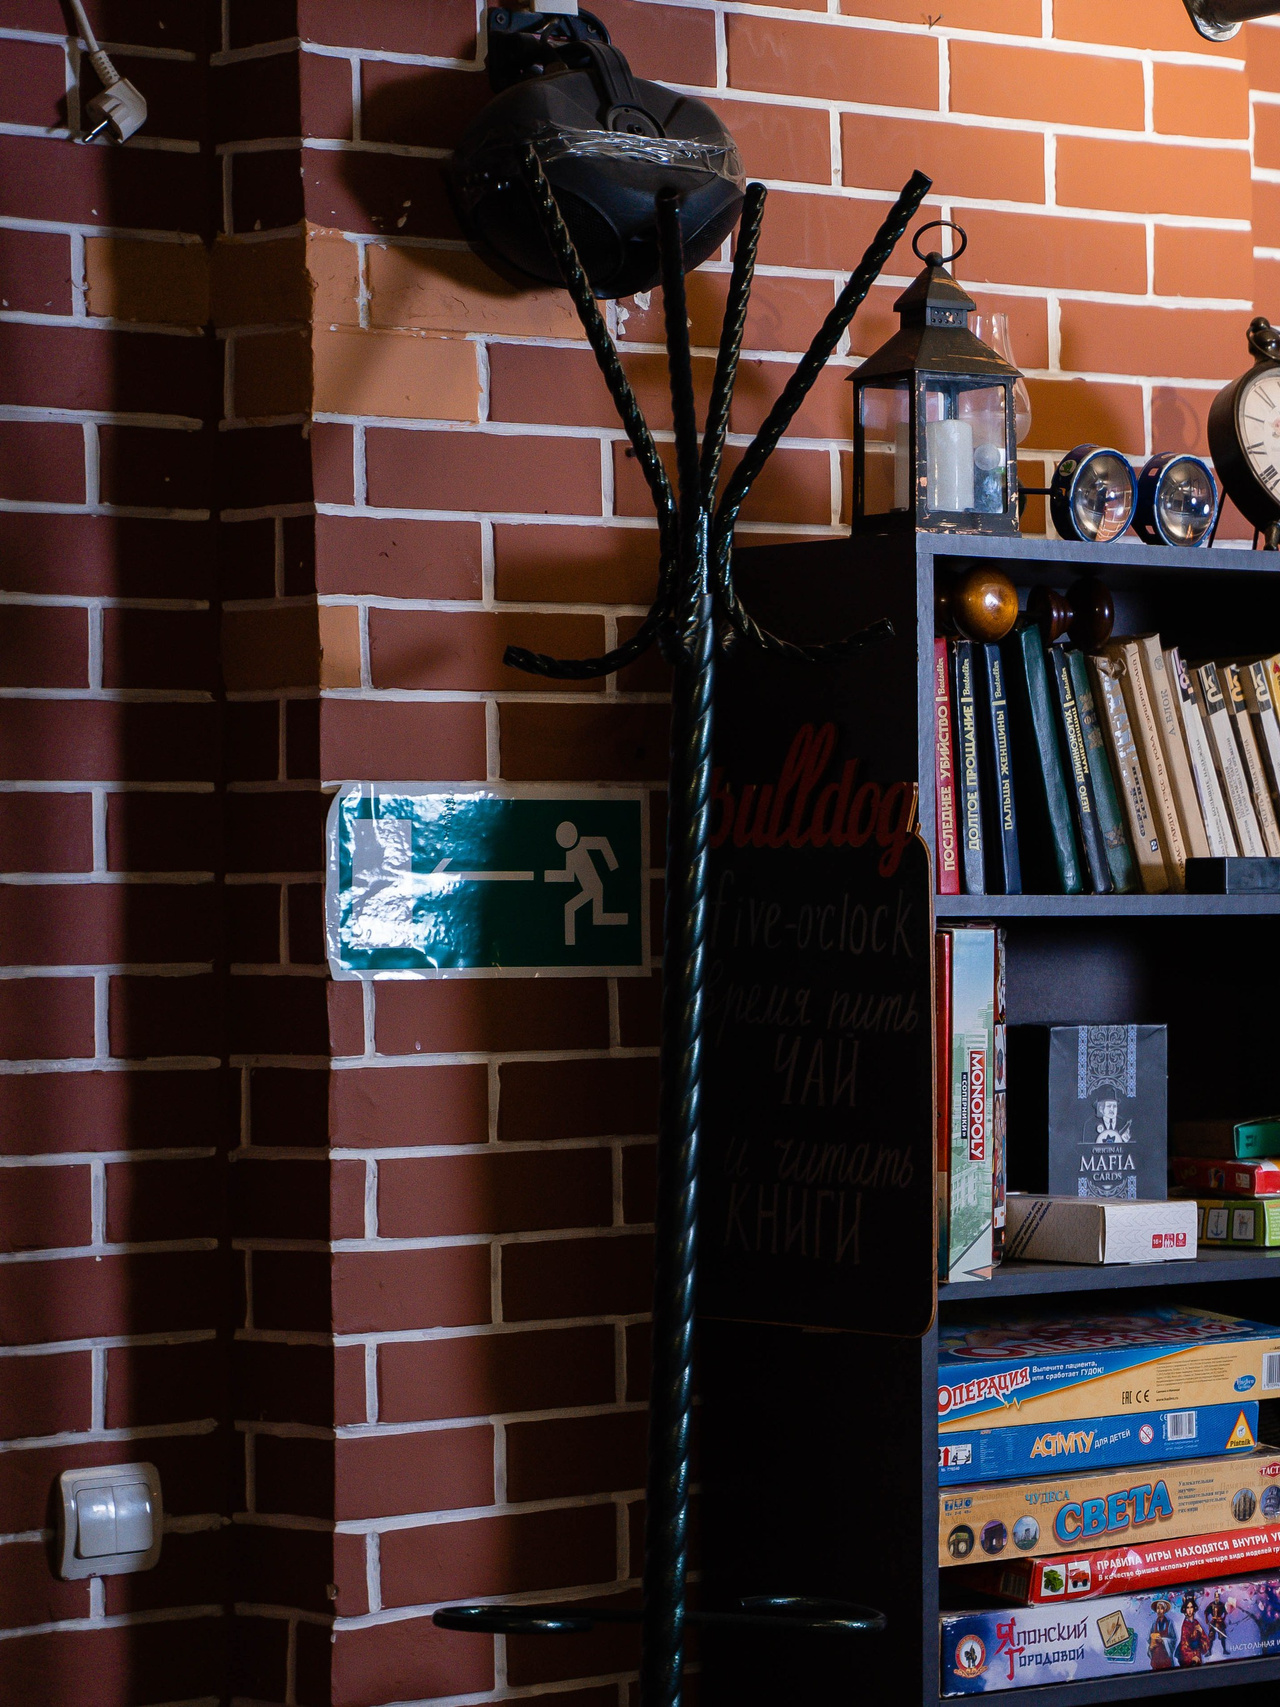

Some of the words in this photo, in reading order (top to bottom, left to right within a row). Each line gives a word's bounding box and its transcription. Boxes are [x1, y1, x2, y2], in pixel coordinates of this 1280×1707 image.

[937, 657, 945, 695] Bestseller
[962, 658, 971, 696] Bestseller
[991, 660, 1000, 699] Bestseller
[1062, 667, 1072, 701] Bestseller
[1160, 688, 1174, 723] БЛОК
[936, 705, 951, 778] УБИЙСТВО
[961, 705, 977, 786] ПРОЩАНИЕ
[996, 710, 1010, 776] ЖЕНЩИНЫ
[1064, 709, 1085, 782] ДЛИННОНОГИХ
[1071, 707, 1089, 774] МАНЕКЕНЩИЦ
[709, 721, 917, 878] bulldog
[1003, 779, 1013, 830] ПАЛЬЦЫ
[1079, 785, 1091, 813] ДЕЛО
[941, 785, 955, 871] ПОСЛЕДНЕЕ
[967, 791, 981, 851] ДОЛГОЕ
[1167, 812, 1178, 845] ГАРДИ
[827, 993, 921, 1037] пить
[773, 1031, 862, 1107] ЧАЙ
[971, 1053, 984, 1159] MONOPOLY
[723, 1136, 750, 1179] и
[774, 1135, 915, 1190] читать
[1080, 1154, 1136, 1172] MAFIA
[1093, 1172, 1122, 1181] CARDS
[723, 1182, 864, 1266] КНИГИ
[938, 1366, 1030, 1414] ОПЕРАЦИЯ
[1045, 1371, 1079, 1381] сработает
[1080, 1366, 1105, 1377] ГУДОК!
[1030, 1430, 1095, 1458] ACTIVITY
[1230, 1438, 1251, 1447] Piatnik
[1025, 1490, 1070, 1505] ЧУДЕСА
[1053, 1479, 1173, 1544] СВЕТА
[1096, 1551, 1143, 1571] ПРАВИЛА
[1145, 1549, 1172, 1563] ИГРЫ
[1174, 1541, 1230, 1560] НАХОДЯТСЯ
[1232, 1534, 1269, 1550] ВНУТРИ
[1104, 1569, 1134, 1581] качестве
[1135, 1565, 1159, 1577] фишек
[1160, 1557, 1205, 1572] используются
[1205, 1555, 1228, 1566] четыре
[1245, 1546, 1272, 1558] моделей
[1229, 1639, 1275, 1652] НАСТОЛЬНАЯ
